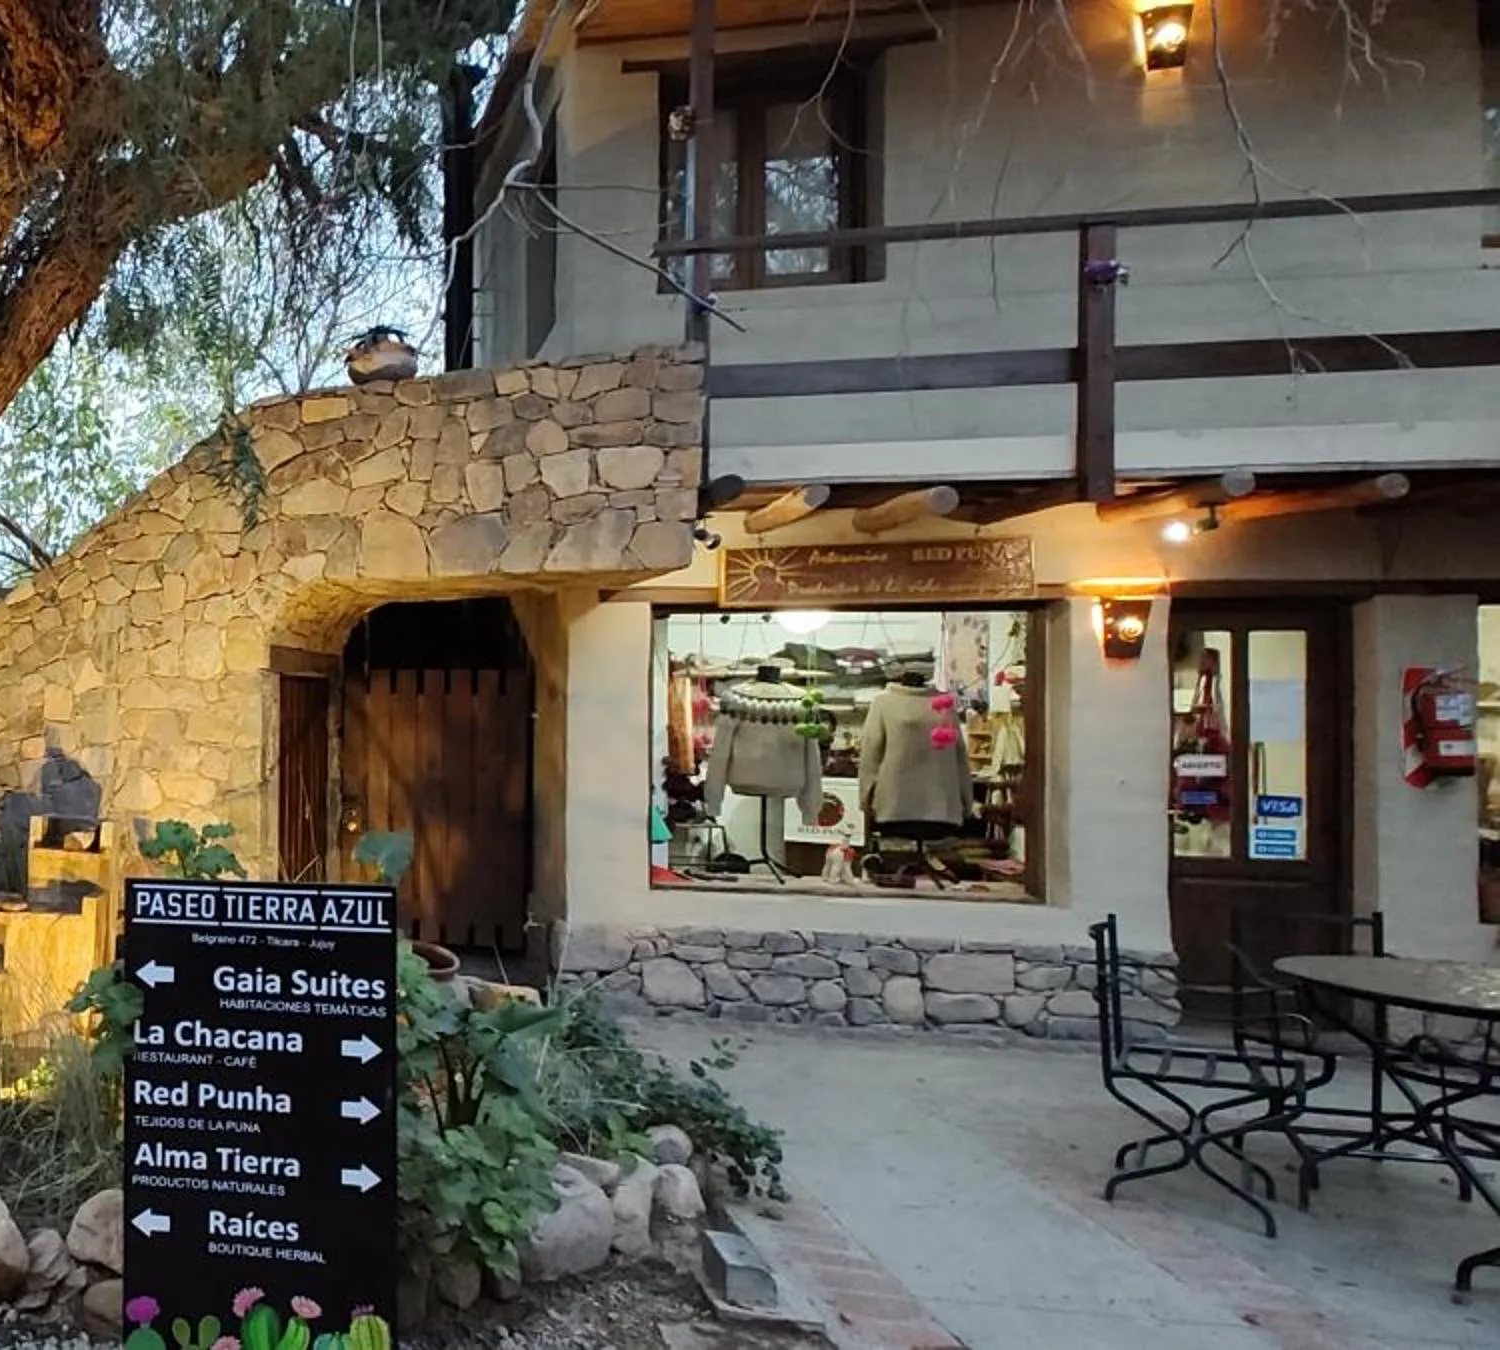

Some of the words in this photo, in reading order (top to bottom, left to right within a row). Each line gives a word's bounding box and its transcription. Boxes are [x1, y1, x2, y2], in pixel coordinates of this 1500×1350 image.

[1261, 799, 1299, 813] VISA
[136, 891, 216, 919] PASEO
[224, 894, 316, 923] TIERRA
[322, 899, 389, 925] AZUL
[191, 932, 236, 945] Belgrano
[238, 935, 257, 945] 472
[308, 936, 336, 951] Jujuy
[213, 966, 281, 994] Gaia
[291, 969, 386, 1000] Suites
[219, 999, 311, 1014] HABITACIONES
[315, 1002, 387, 1018] TEMÁTICAS
[133, 1020, 165, 1045] La
[174, 1021, 303, 1053] Chacana
[134, 1080, 188, 1107] Red
[199, 1083, 291, 1114] Punha
[134, 1115, 184, 1129] TEJIDOS
[187, 1118, 205, 1130] DE
[207, 1119, 224, 1131] LA
[225, 1120, 261, 1133] PUNA
[134, 1143, 208, 1171] Alma
[216, 1146, 301, 1178] Tierra
[132, 1174, 209, 1190] PRODUCTOS
[211, 1180, 286, 1196] NATURALES
[209, 1210, 300, 1242] Raíces
[208, 1241, 273, 1258] BOUTIQUE
[275, 1248, 327, 1264] HERBAL
